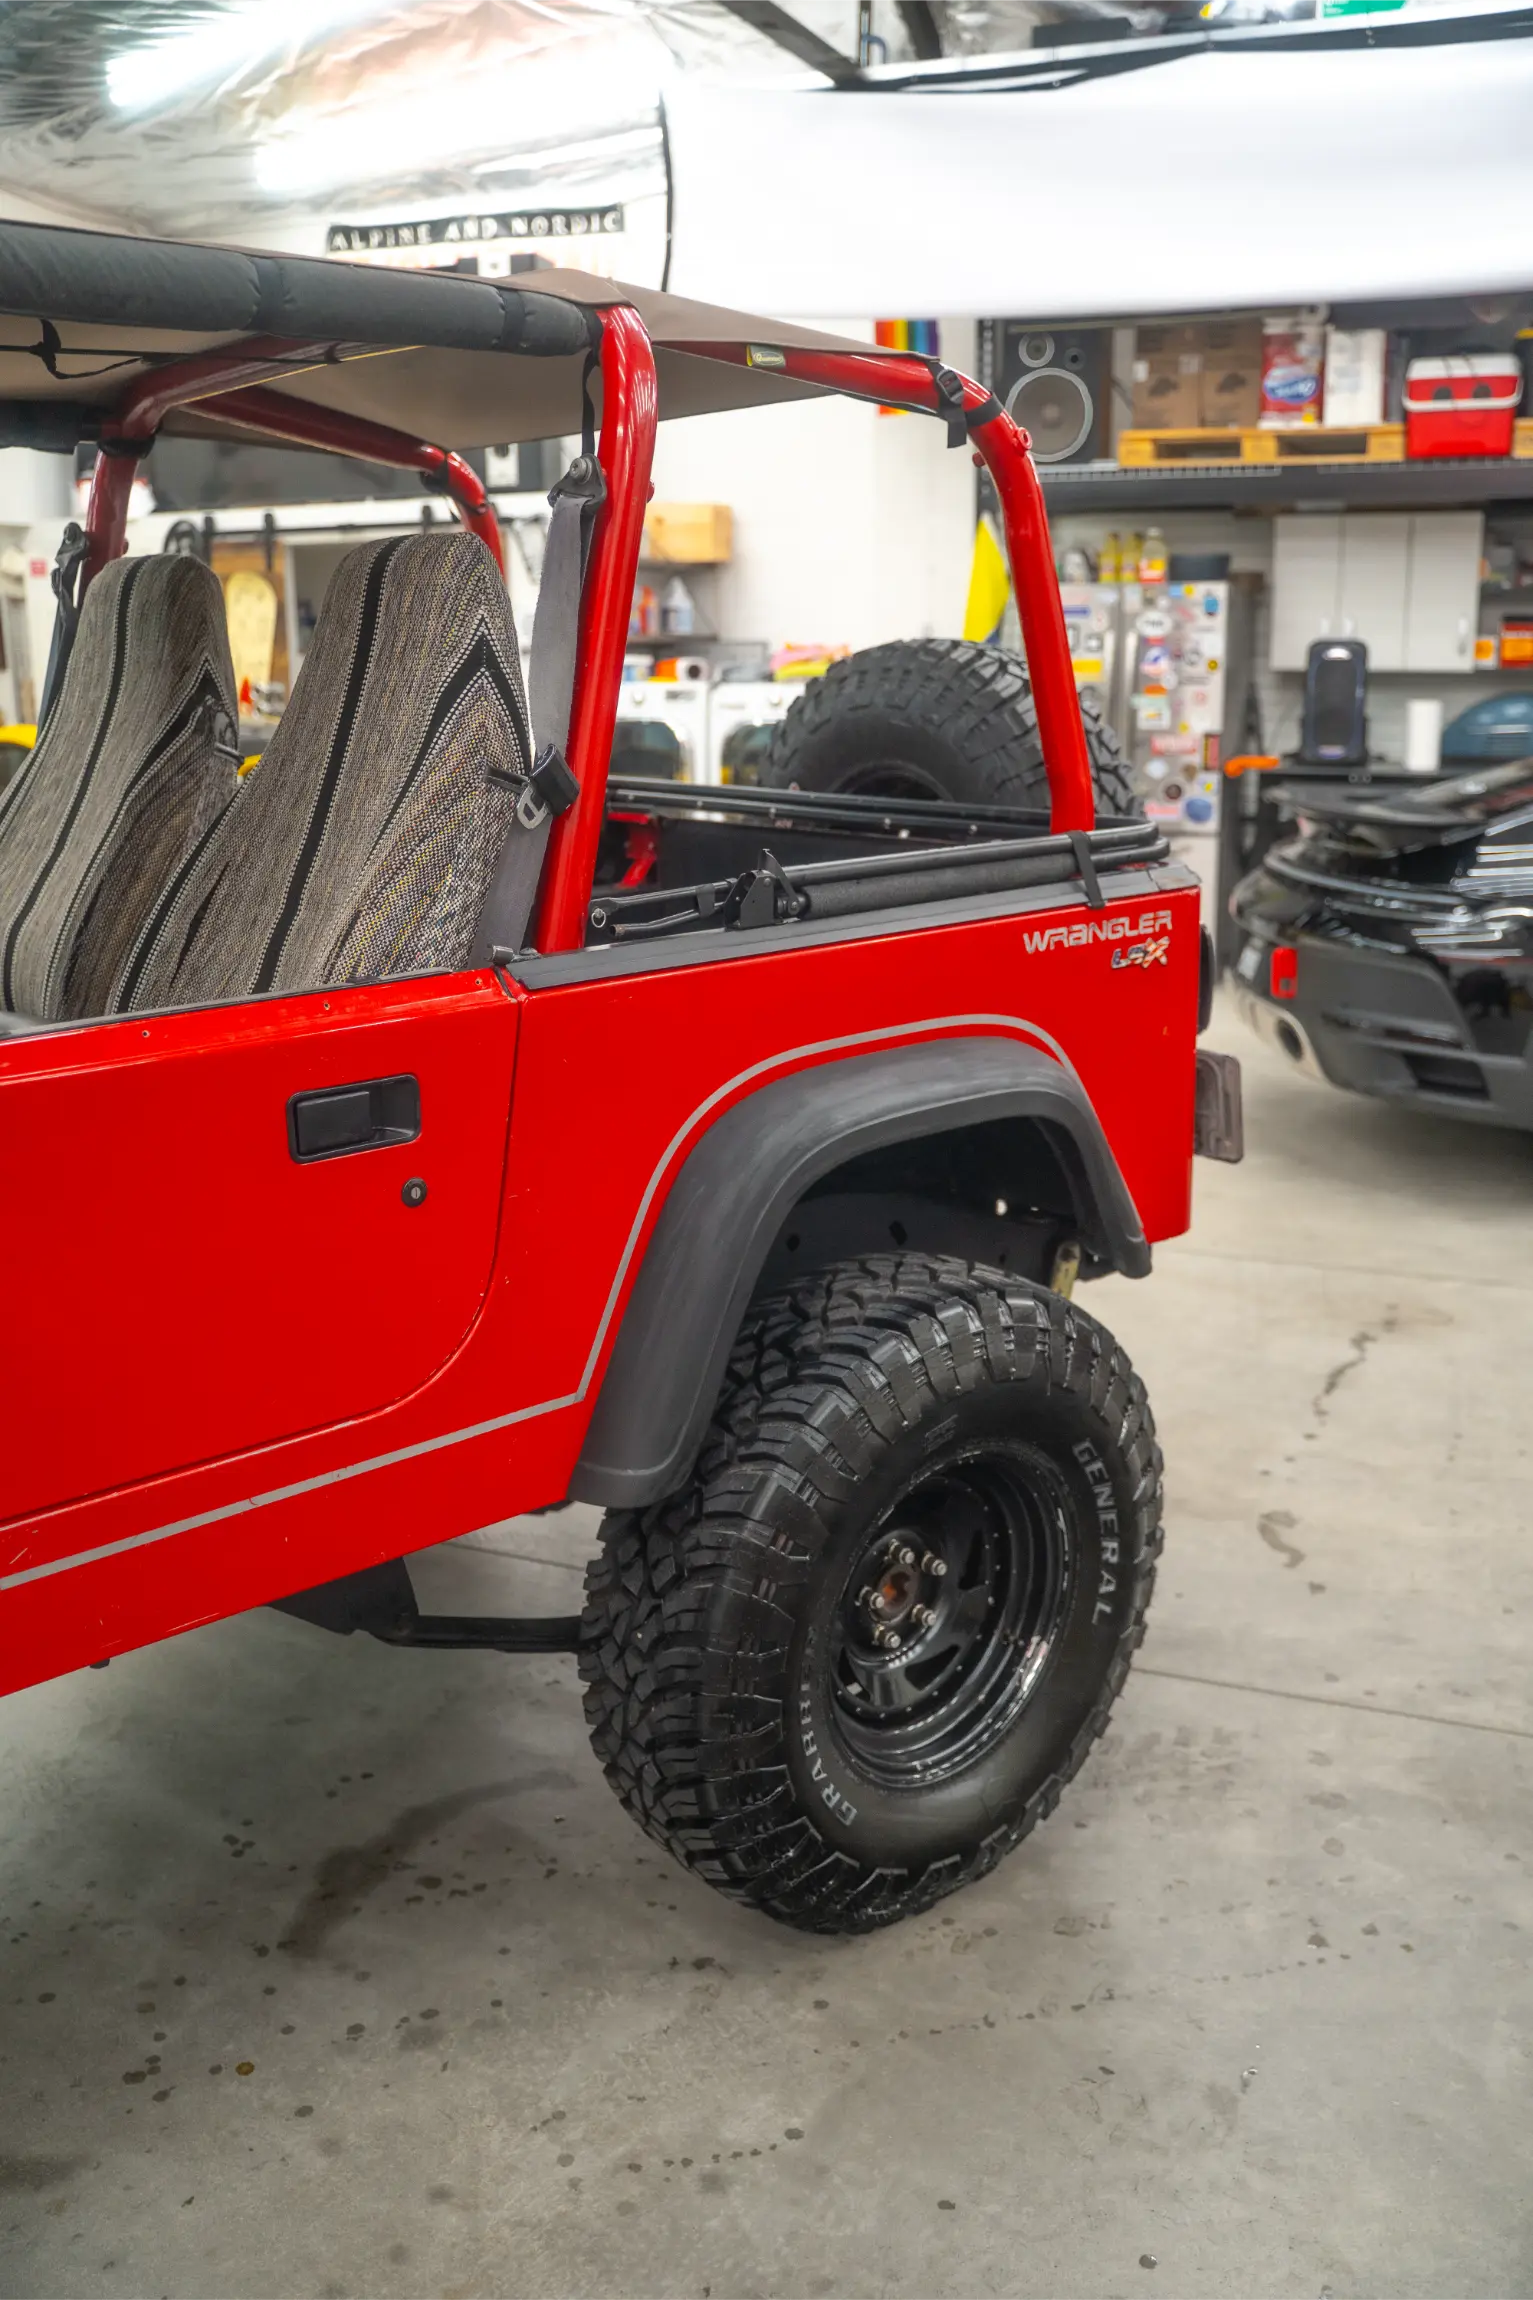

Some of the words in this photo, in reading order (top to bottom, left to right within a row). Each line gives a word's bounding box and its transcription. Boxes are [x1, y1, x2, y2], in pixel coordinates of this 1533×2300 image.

[330, 223, 432, 250] ALPINE
[443, 216, 499, 242] AND
[510, 209, 622, 237] NORDIC
[1022, 909, 1173, 955] WRANGLER
[1072, 1438, 1120, 1626] GENERAL
